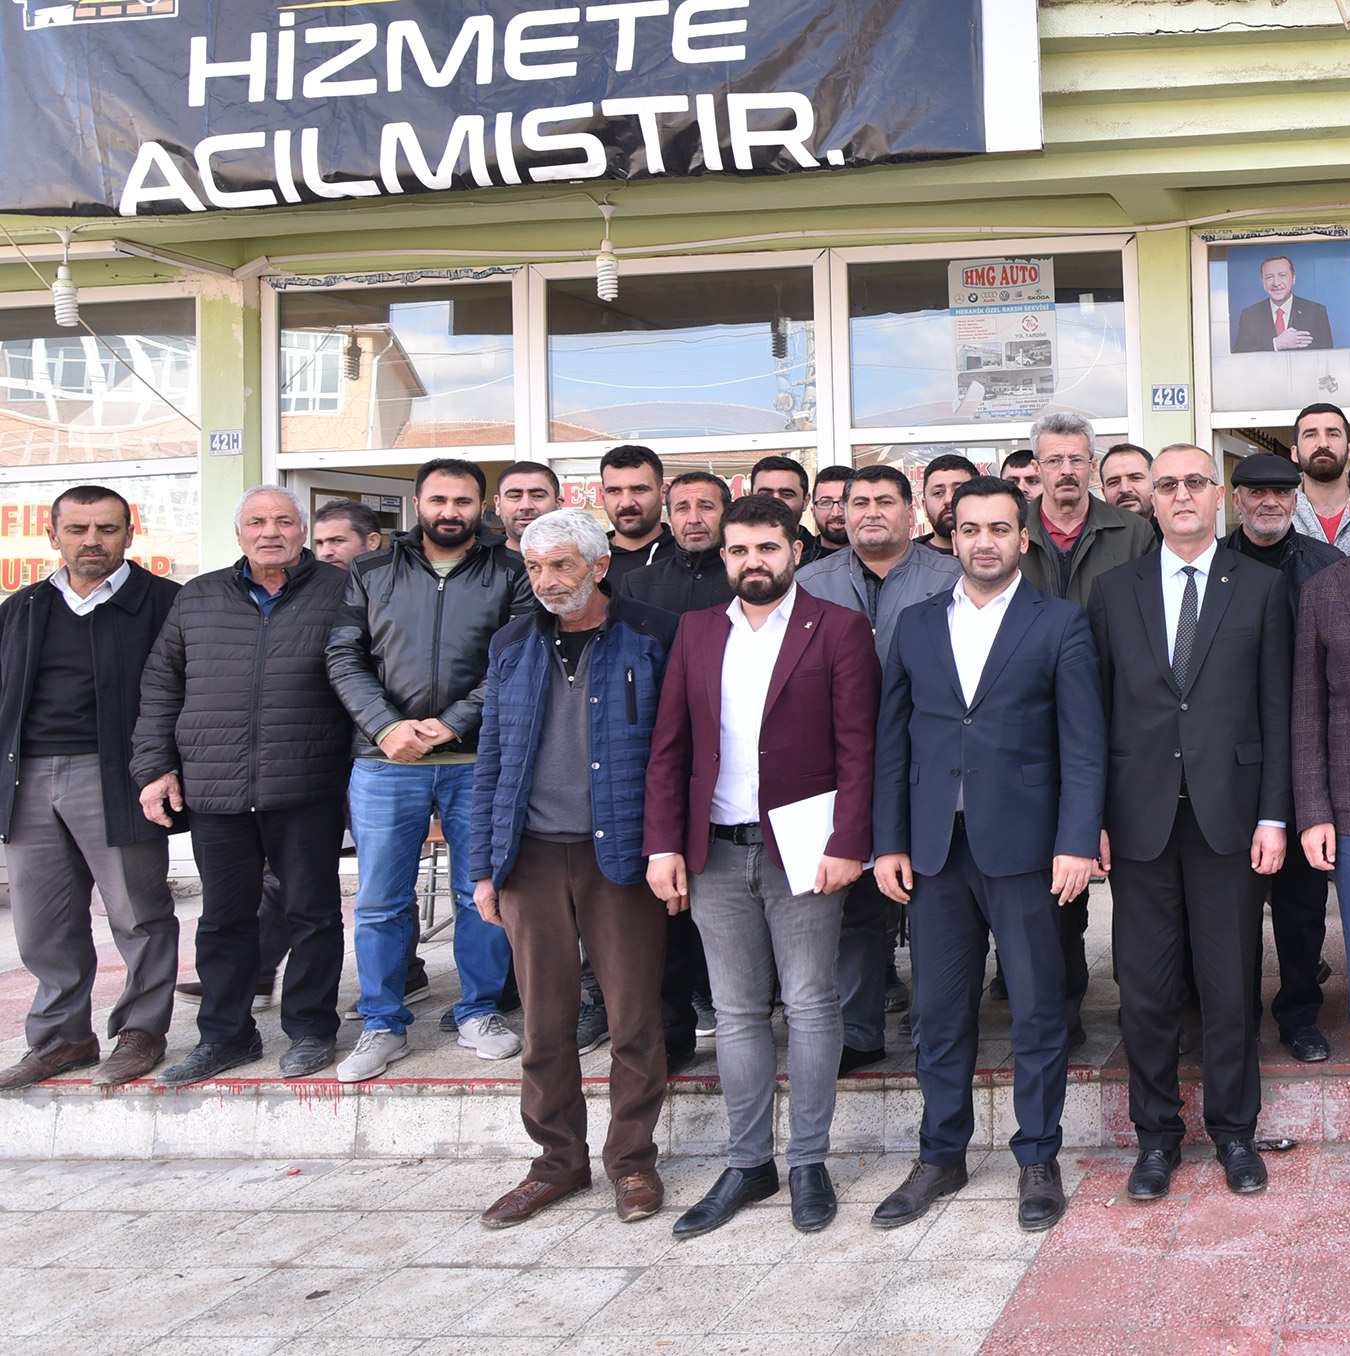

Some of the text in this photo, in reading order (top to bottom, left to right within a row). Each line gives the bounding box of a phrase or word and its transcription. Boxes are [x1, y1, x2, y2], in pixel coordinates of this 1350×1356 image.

[188, 0, 750, 107] HİZMETE
[965, 265, 1038, 286] HMG AUTO
